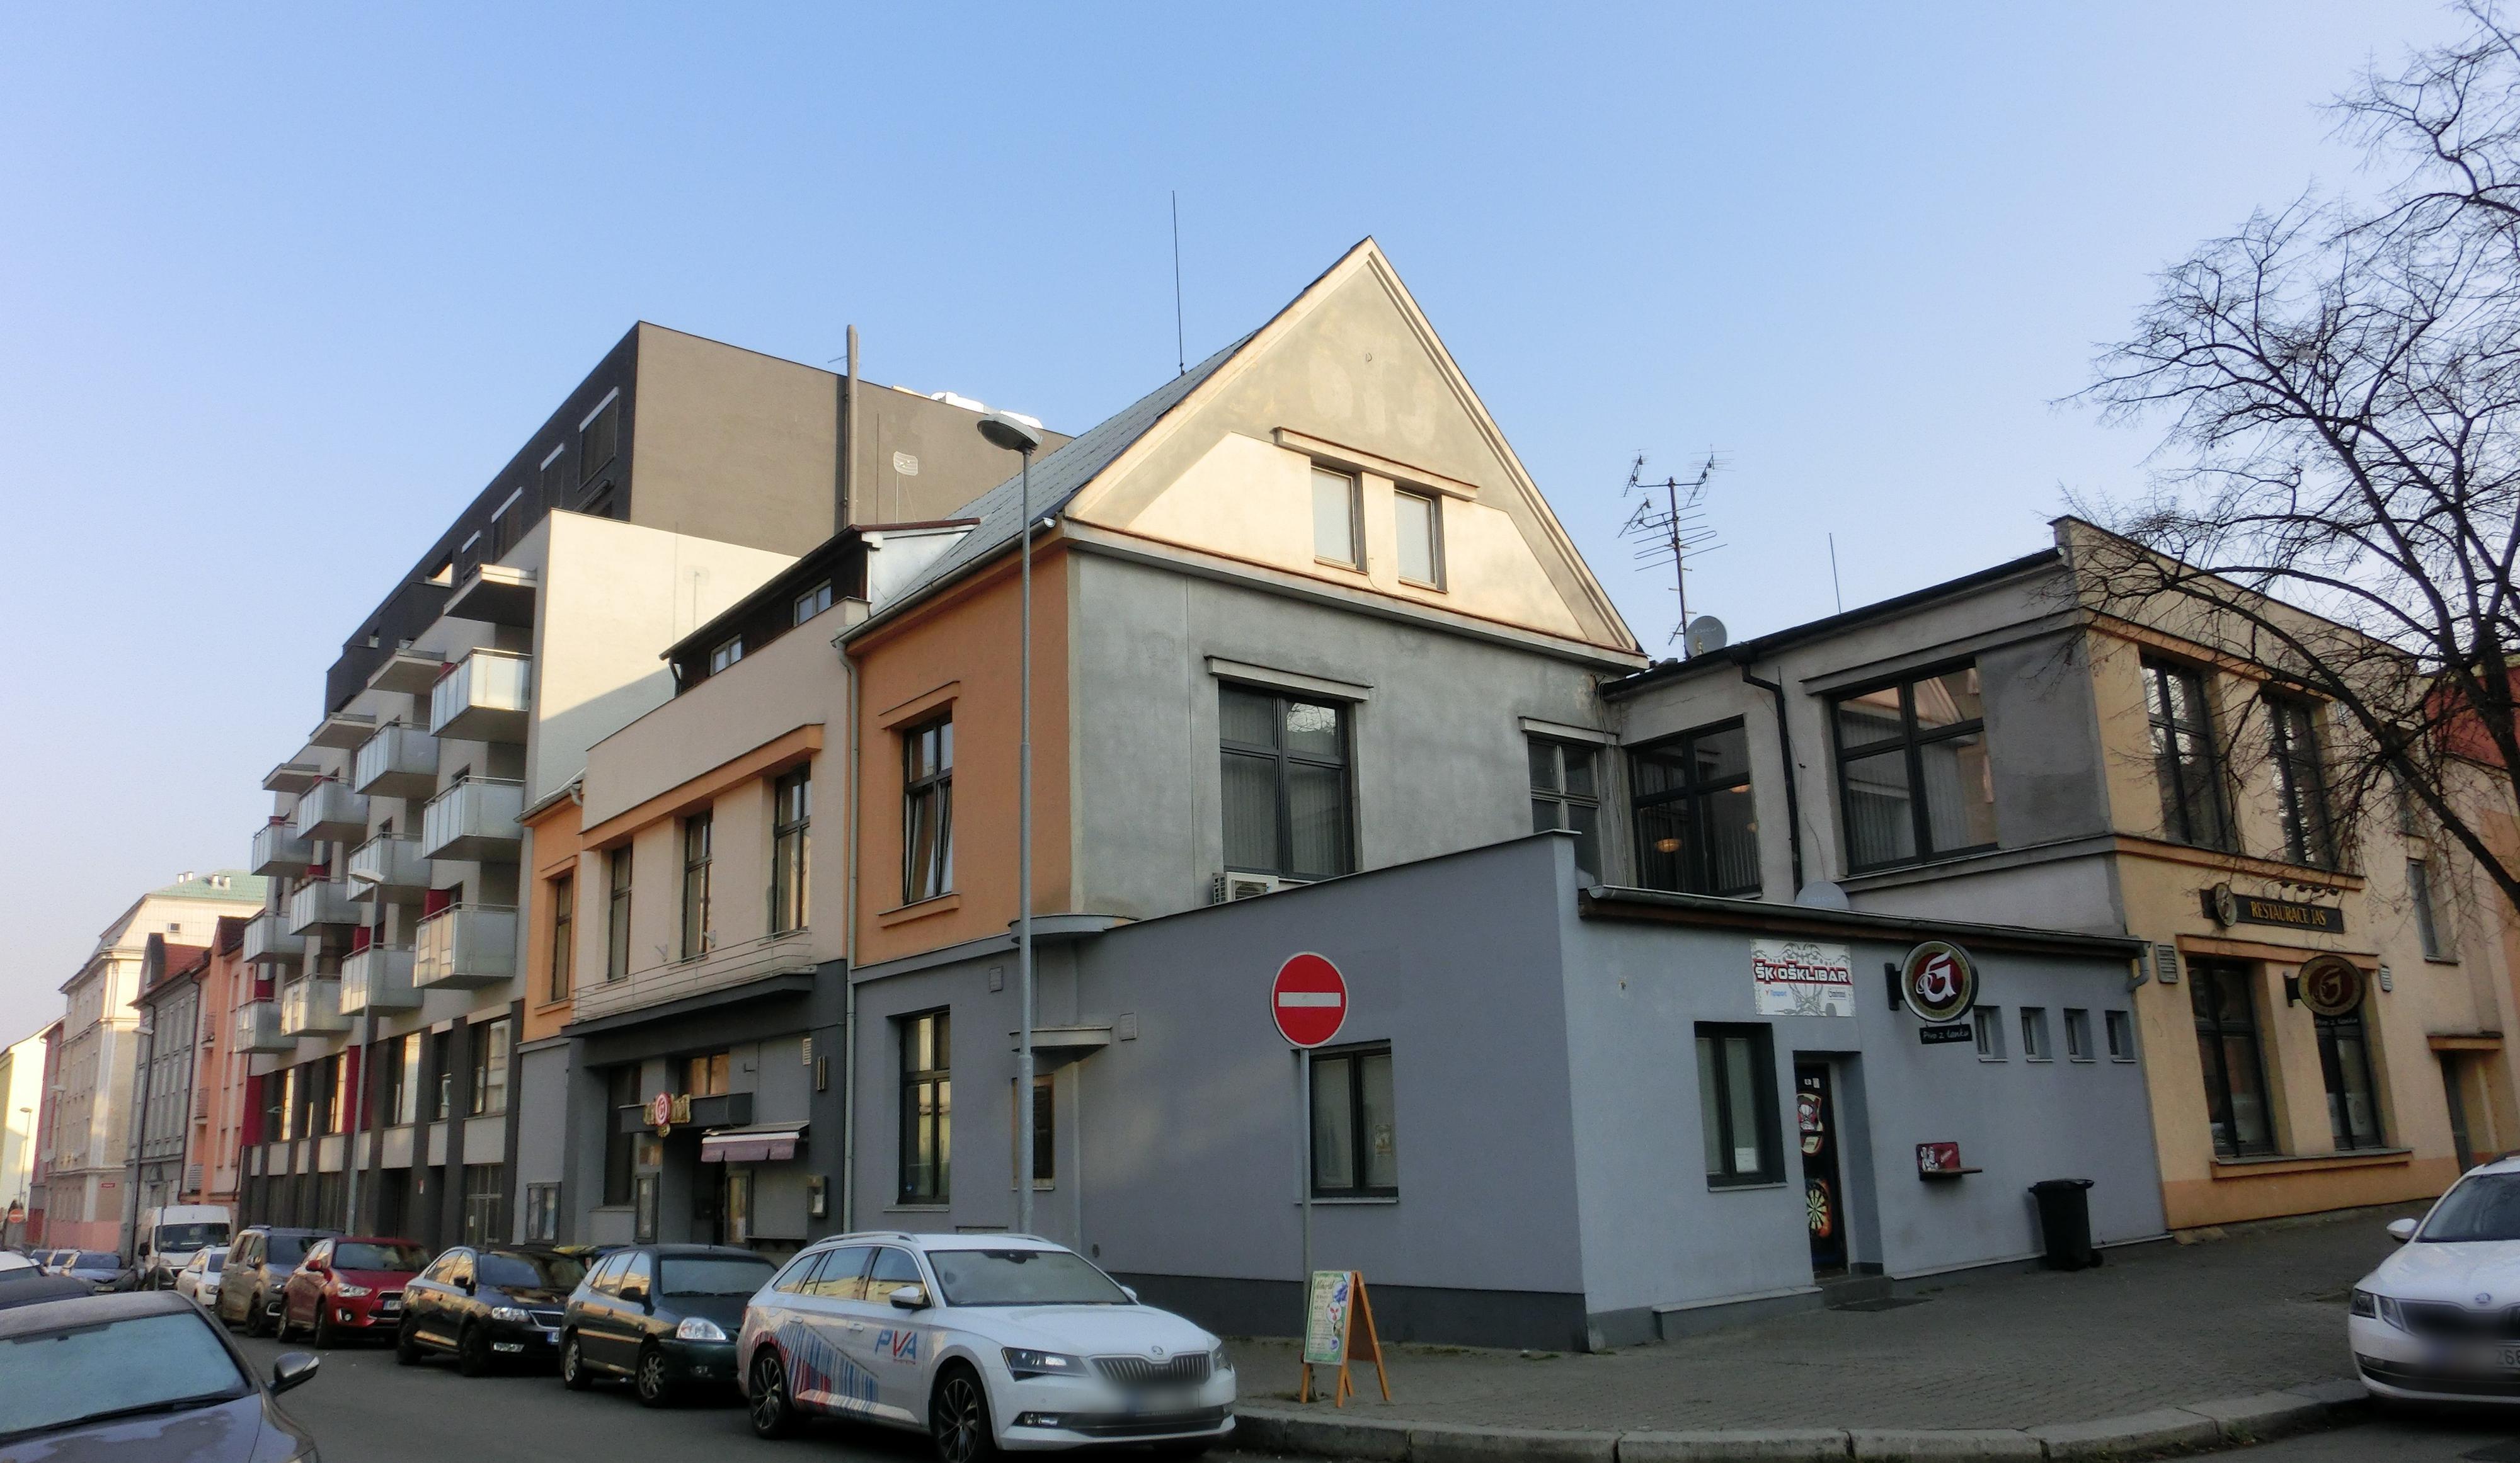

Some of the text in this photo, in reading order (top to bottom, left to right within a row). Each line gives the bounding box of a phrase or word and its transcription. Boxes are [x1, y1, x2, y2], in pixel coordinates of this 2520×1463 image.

[2250, 901, 2327, 926] RESTAURACE JAS
[1777, 964, 1848, 982] OŠKLIBAR
[874, 1329, 917, 1360] PVA
